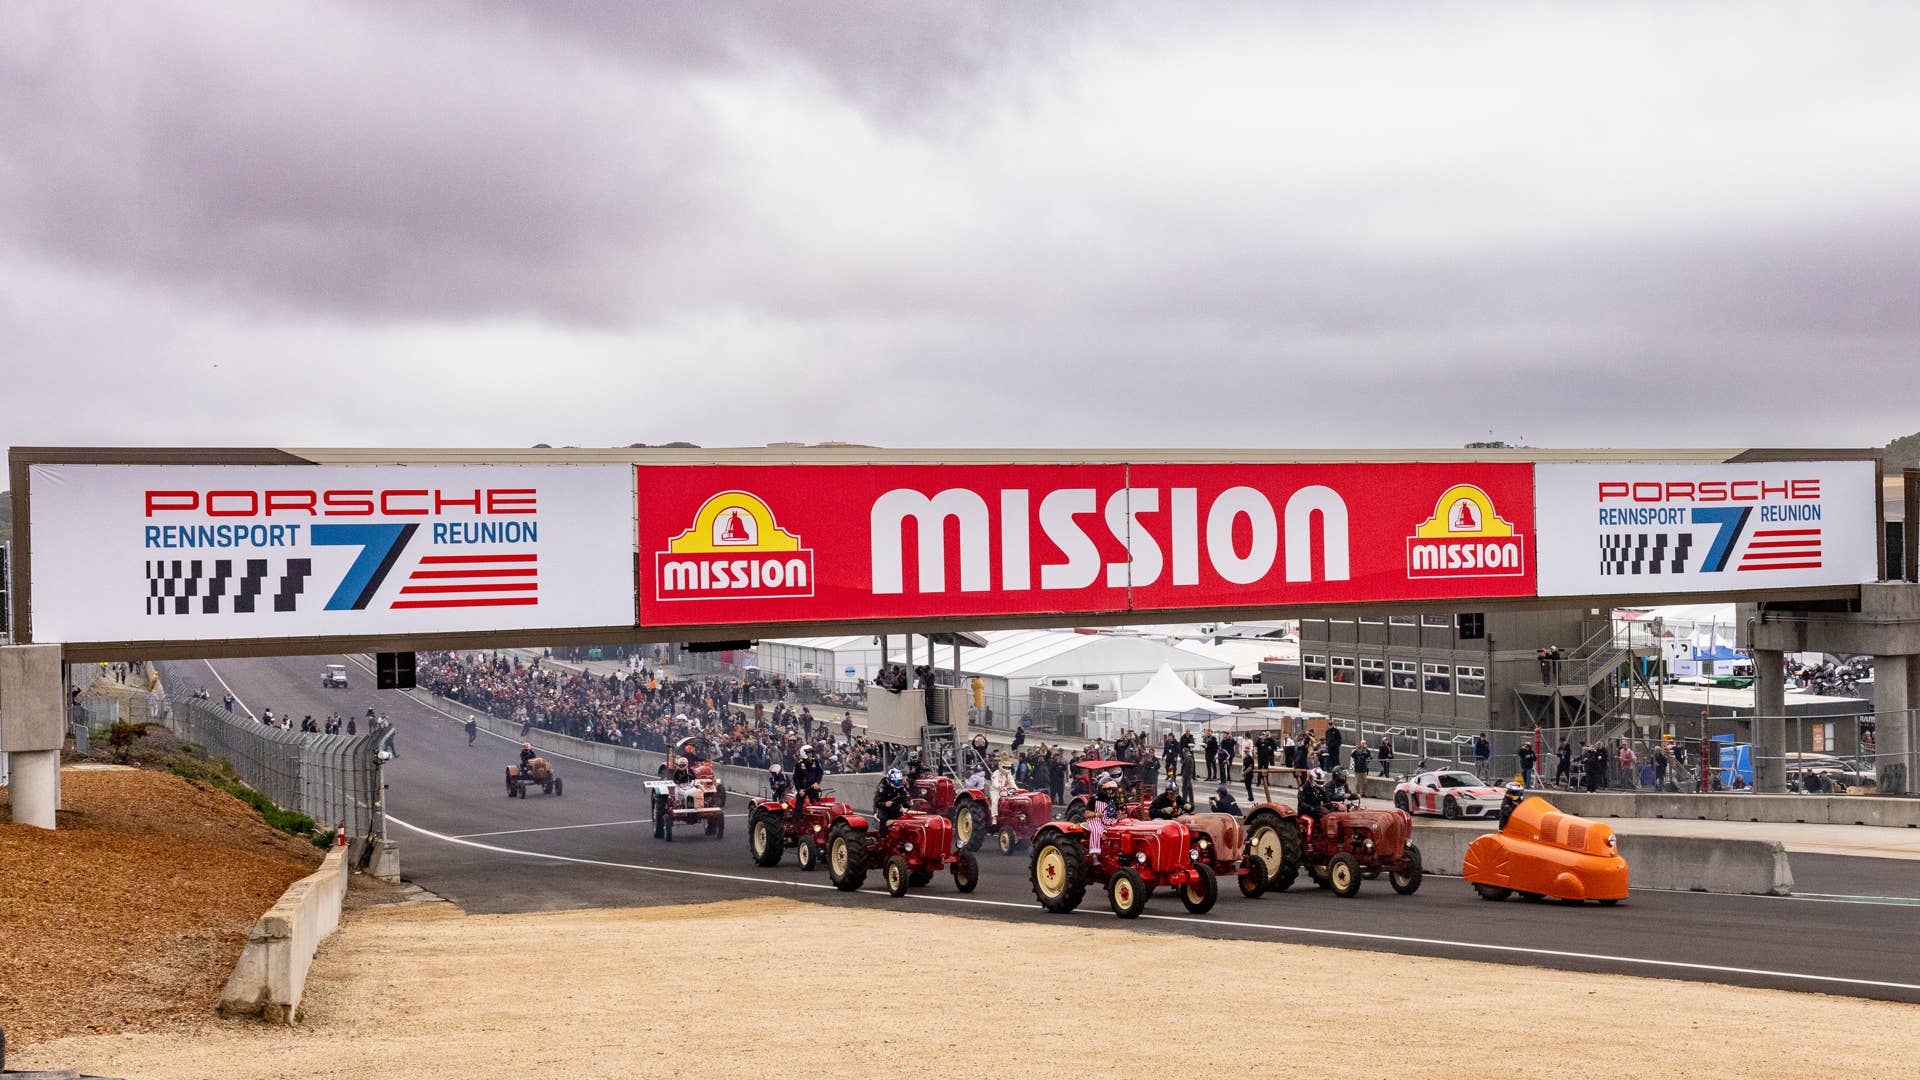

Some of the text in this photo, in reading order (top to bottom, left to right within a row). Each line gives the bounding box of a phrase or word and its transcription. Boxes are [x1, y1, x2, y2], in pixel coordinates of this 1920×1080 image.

[145, 488, 537, 517] PORSCHE
[1599, 479, 1821, 502] PORSCHE
[870, 484, 1350, 595] MISSION
[1599, 503, 1821, 573] RENNSPORT 7 REUNION
[145, 520, 538, 611] RENNSPORT 7 REUNION
[1412, 542, 1519, 570] MISSION
[663, 558, 807, 591] MISSION
